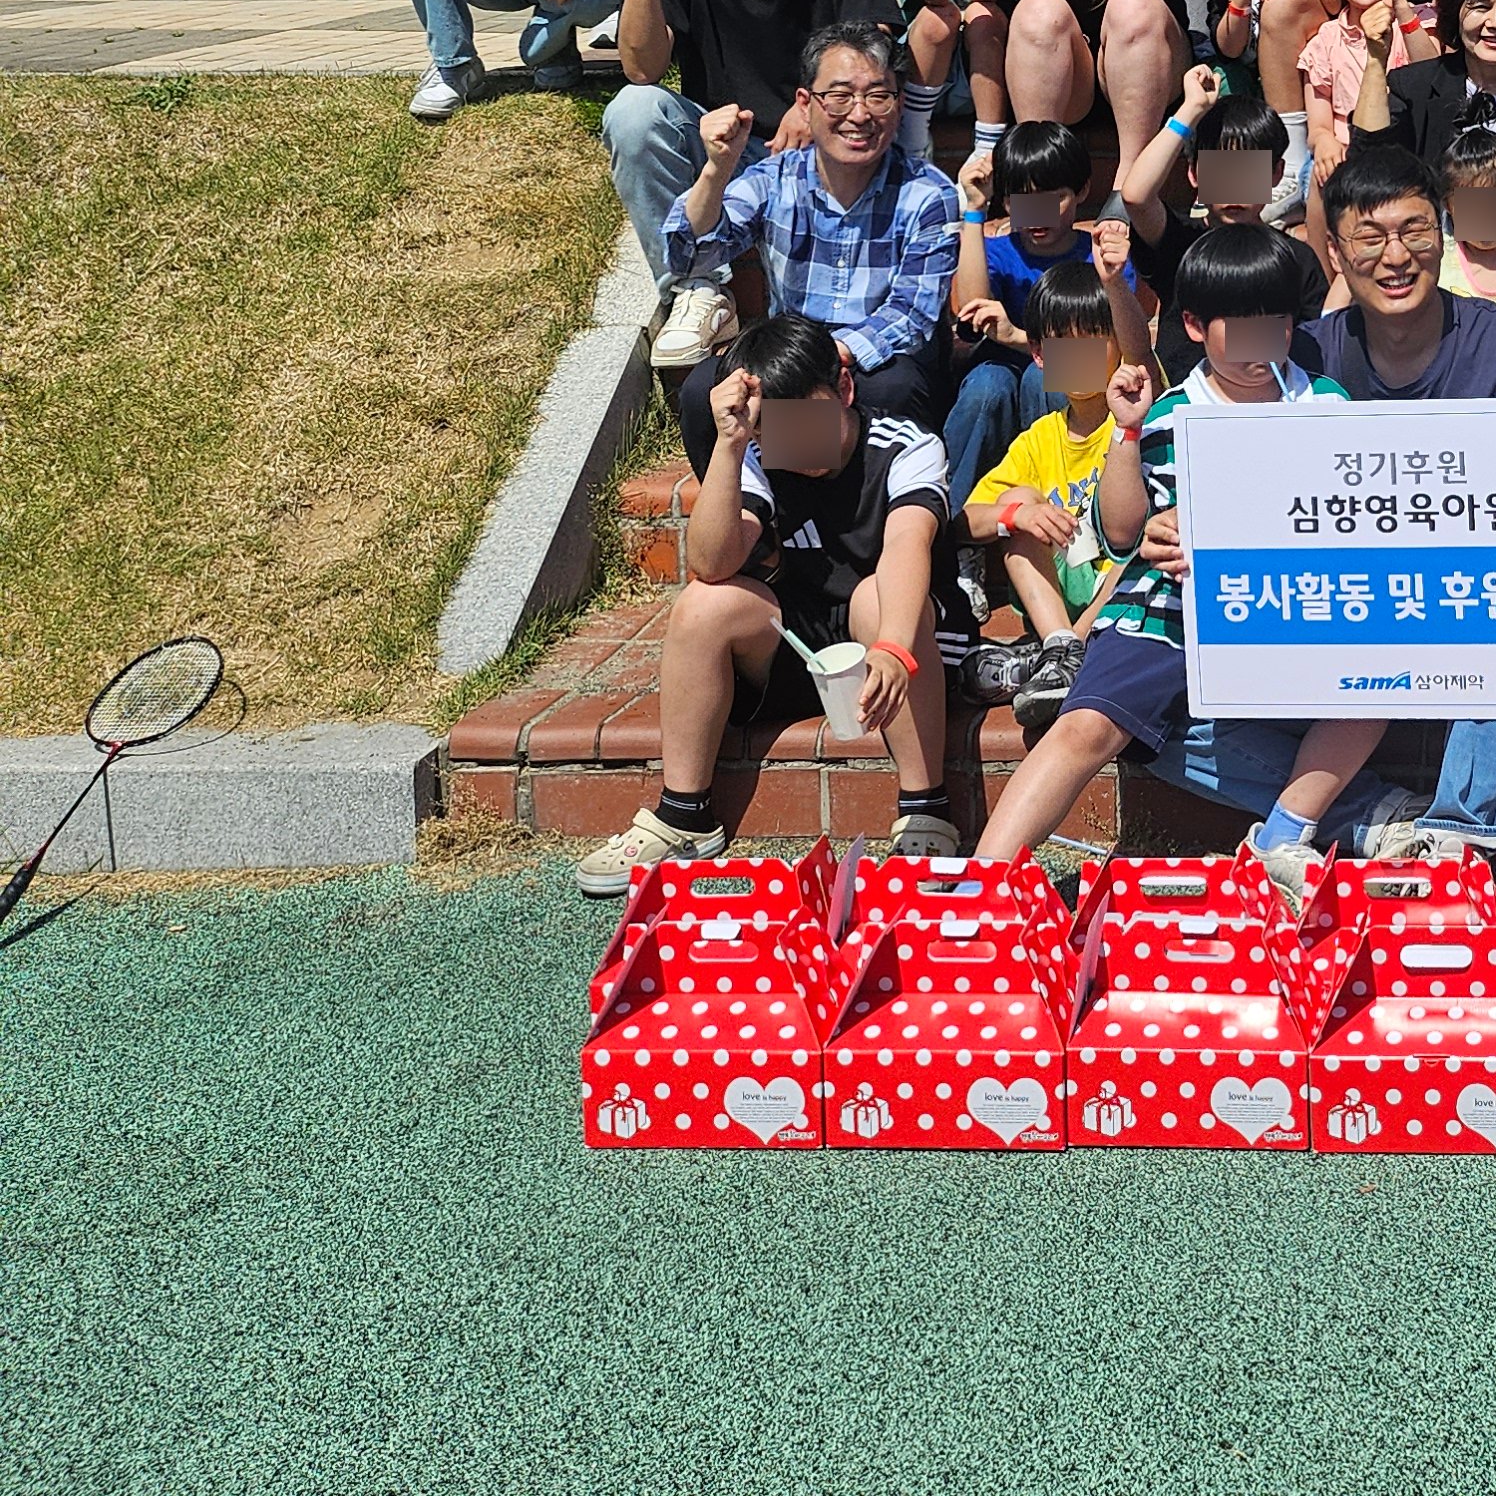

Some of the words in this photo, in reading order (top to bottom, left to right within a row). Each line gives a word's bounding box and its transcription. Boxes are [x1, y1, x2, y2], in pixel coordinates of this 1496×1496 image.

[1333, 450, 1468, 486] 정기후원
[1216, 573, 1375, 622] 봉사활동
[1387, 573, 1427, 621] 및
[1415, 674, 1484, 690] 삼아제약
[742, 1091, 761, 1101] love
[984, 1092, 1004, 1101] love
[1228, 1091, 1248, 1101] love
[1474, 1097, 1494, 1107] love
